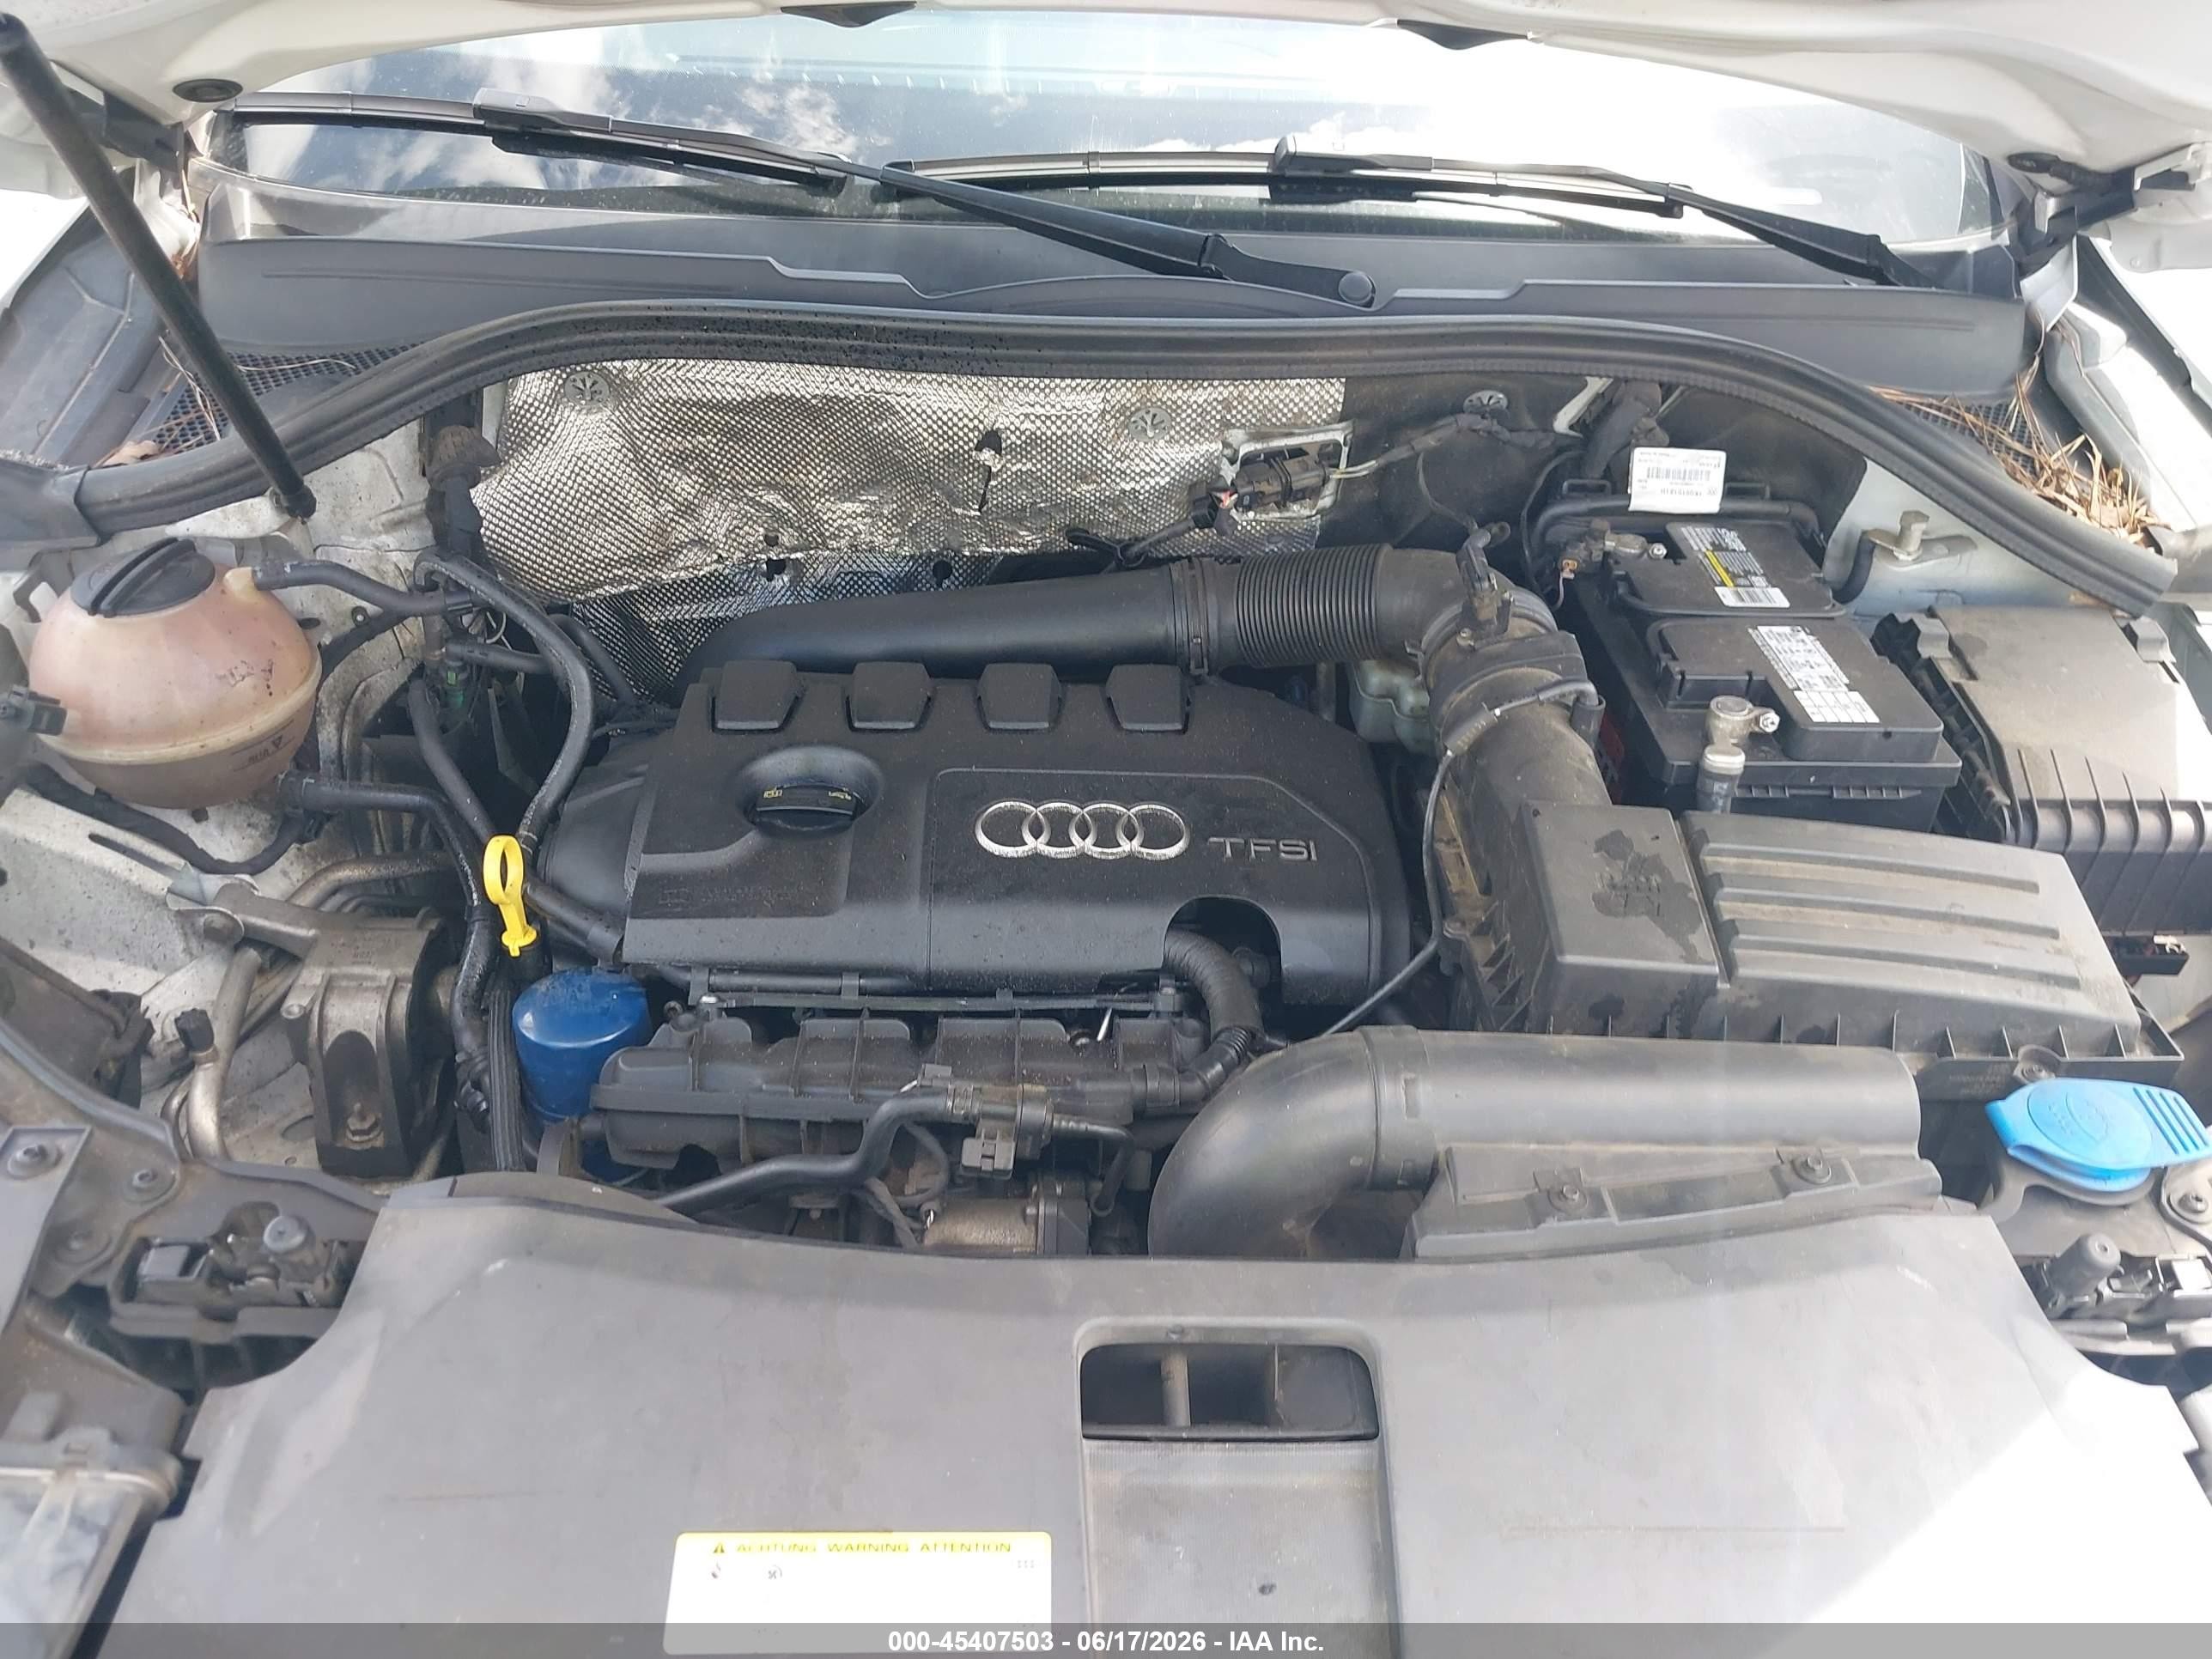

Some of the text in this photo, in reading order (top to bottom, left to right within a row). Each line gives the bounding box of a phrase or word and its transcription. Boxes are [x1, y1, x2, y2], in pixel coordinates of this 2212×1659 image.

[1207, 836, 1318, 862] TFSI
[827, 1542, 909, 1553] WARNING
[920, 1542, 1012, 1553] ATTENTION
